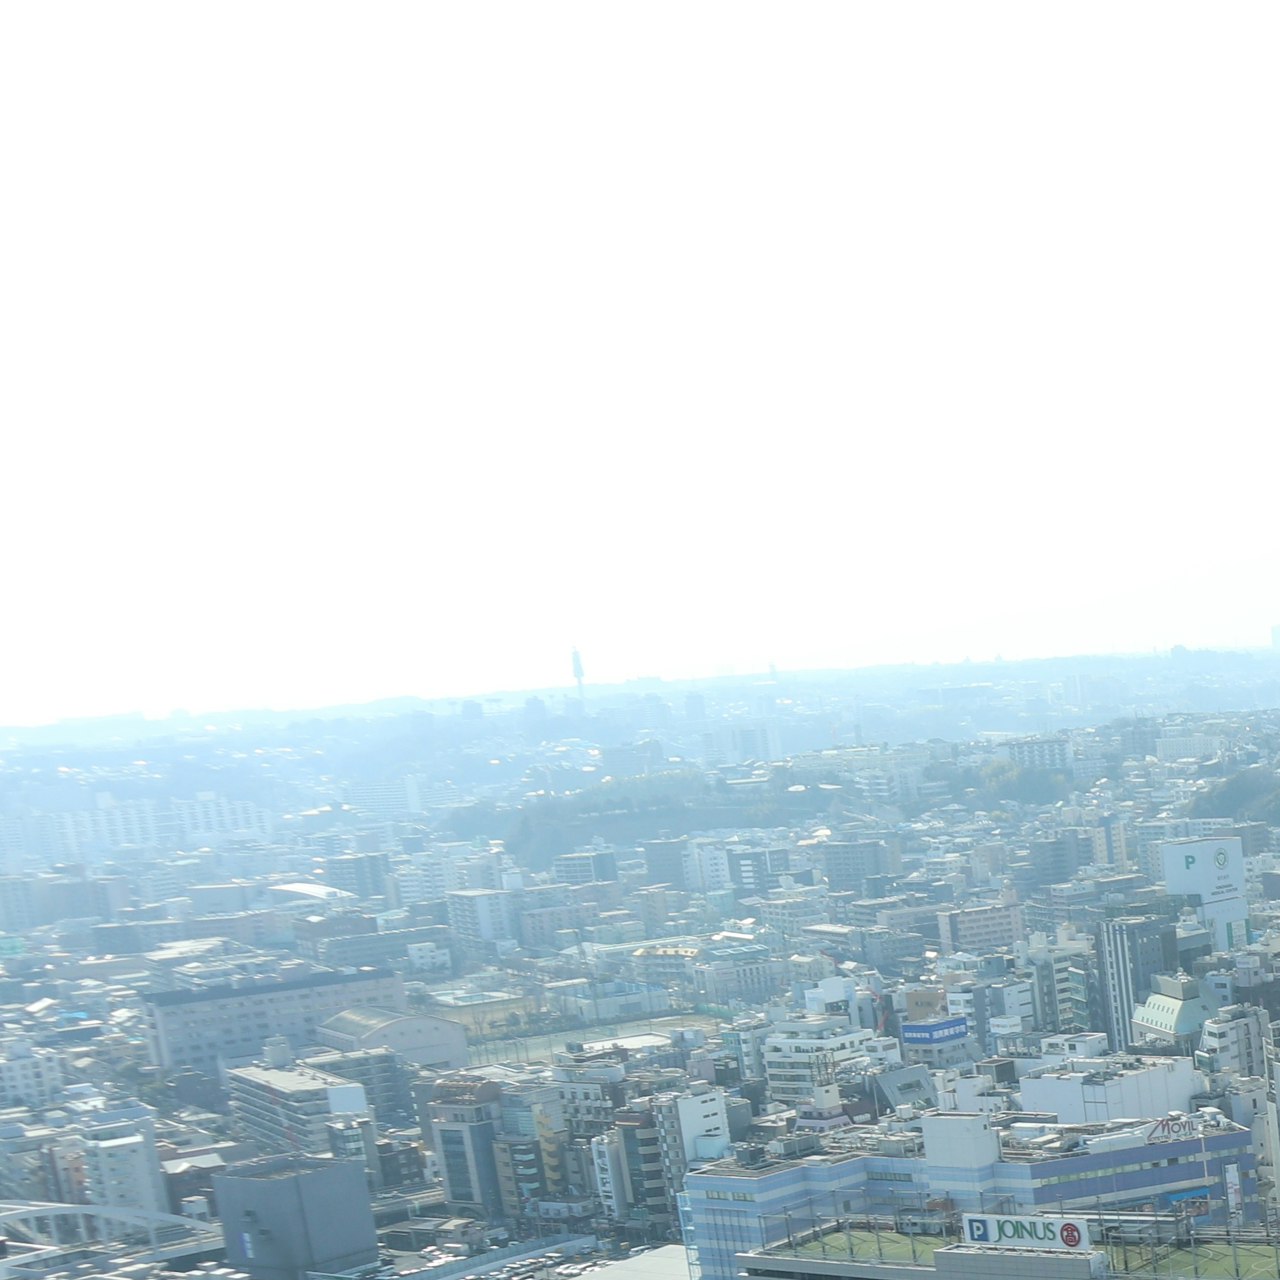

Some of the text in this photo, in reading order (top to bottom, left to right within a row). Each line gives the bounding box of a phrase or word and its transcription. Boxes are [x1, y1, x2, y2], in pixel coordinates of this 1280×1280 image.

[1184, 855, 1196, 870] P
[972, 1219, 1056, 1243] P JOINUS
